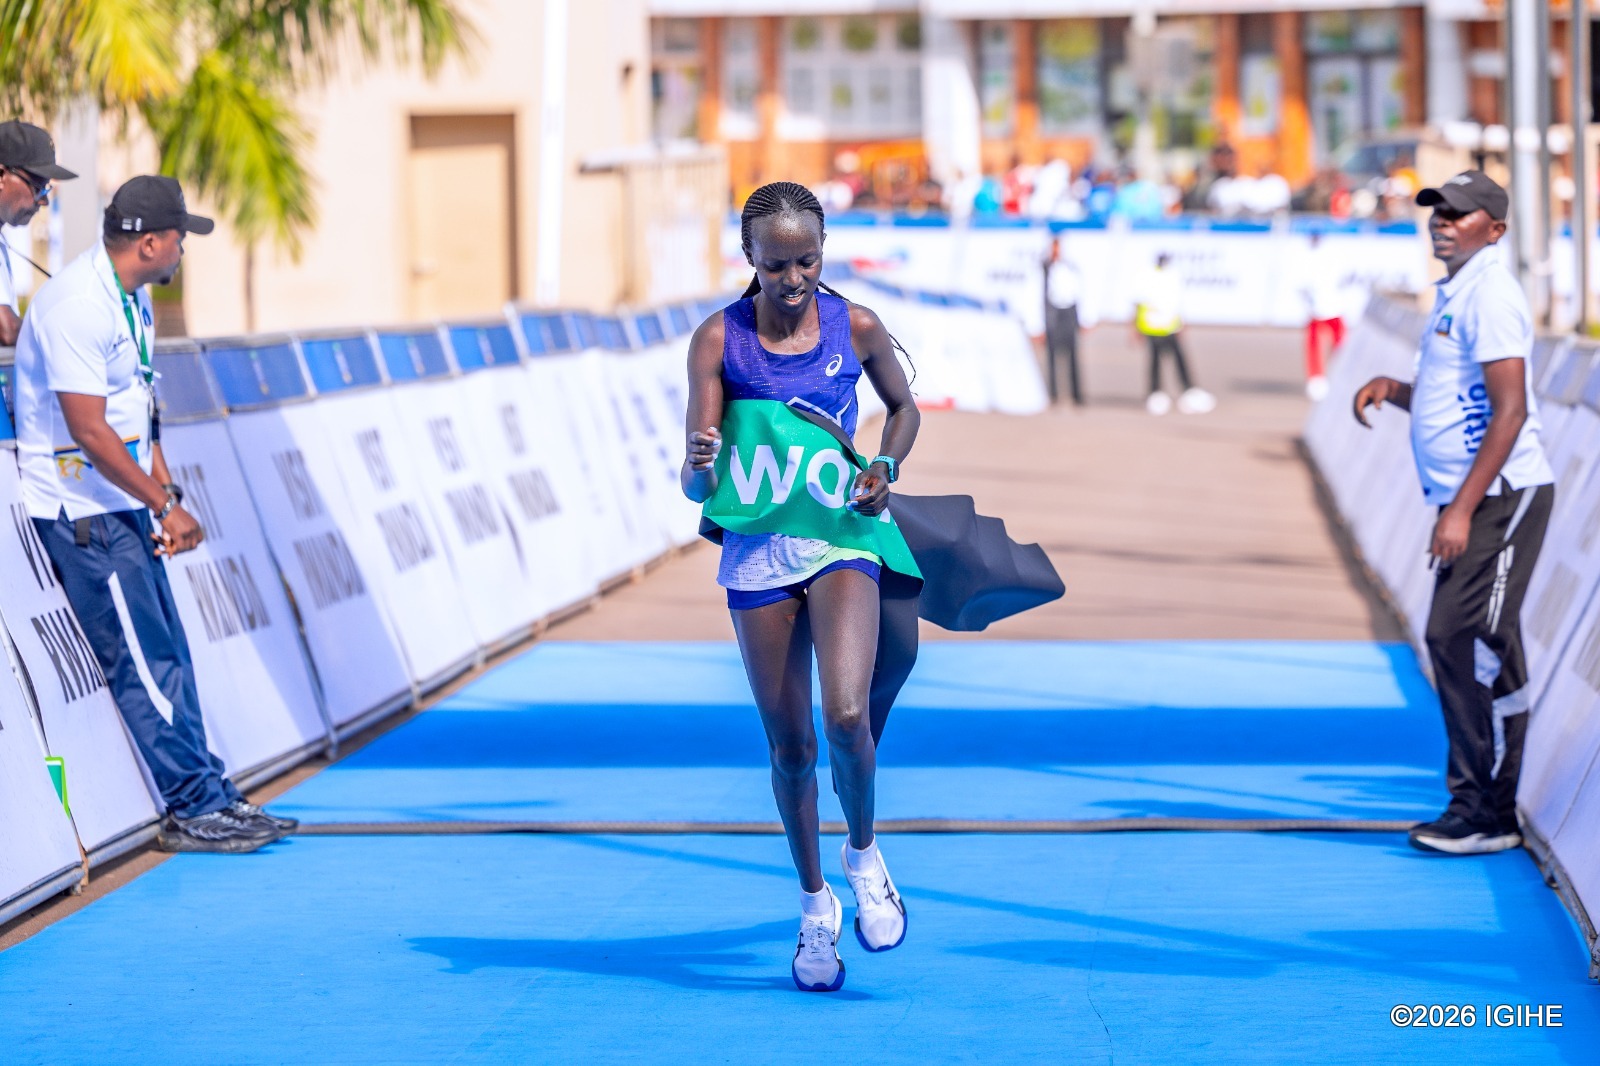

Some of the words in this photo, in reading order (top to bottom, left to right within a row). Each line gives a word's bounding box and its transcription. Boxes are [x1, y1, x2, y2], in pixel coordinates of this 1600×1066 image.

[170, 463, 223, 544] SIT
[184, 552, 272, 644] RWANDA
[30, 607, 108, 705] RWA
